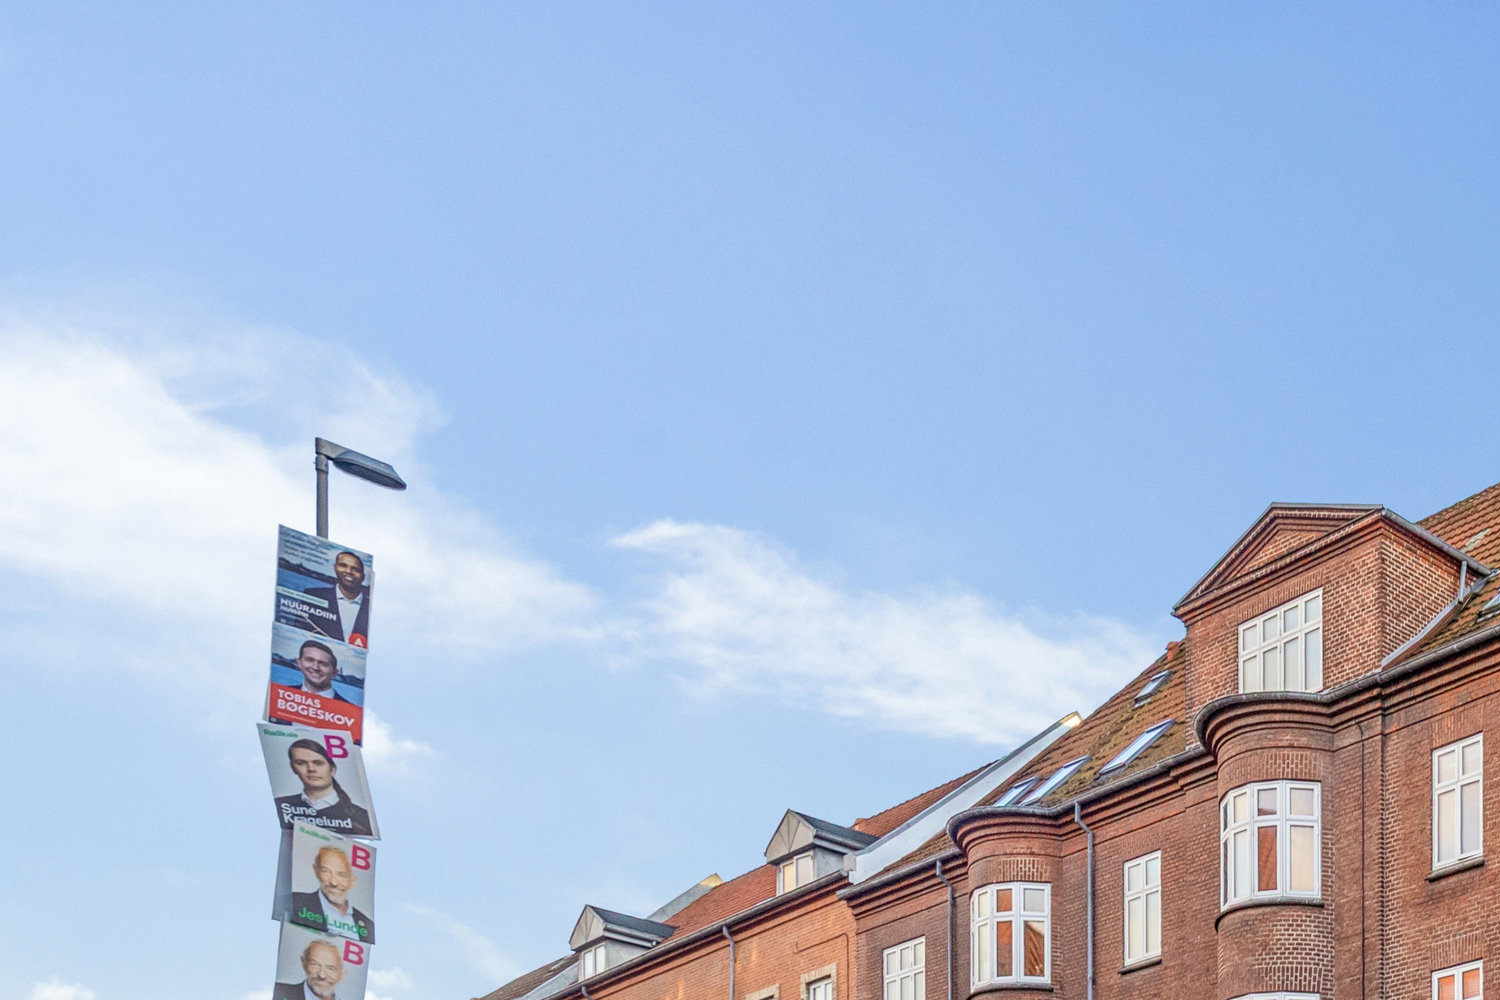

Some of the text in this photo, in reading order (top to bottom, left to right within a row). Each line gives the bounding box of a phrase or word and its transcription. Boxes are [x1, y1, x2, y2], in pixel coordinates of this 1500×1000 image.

[280, 598, 337, 621] NUURADIIN
[278, 689, 321, 708] TOBIAS
[277, 699, 355, 727] BØGESKOV
[323, 735, 349, 759] B
[281, 803, 317, 816] Sune
[352, 844, 371, 871] B
[298, 907, 323, 923] Jes
[326, 914, 368, 937] Lunde
[343, 940, 364, 966] B
